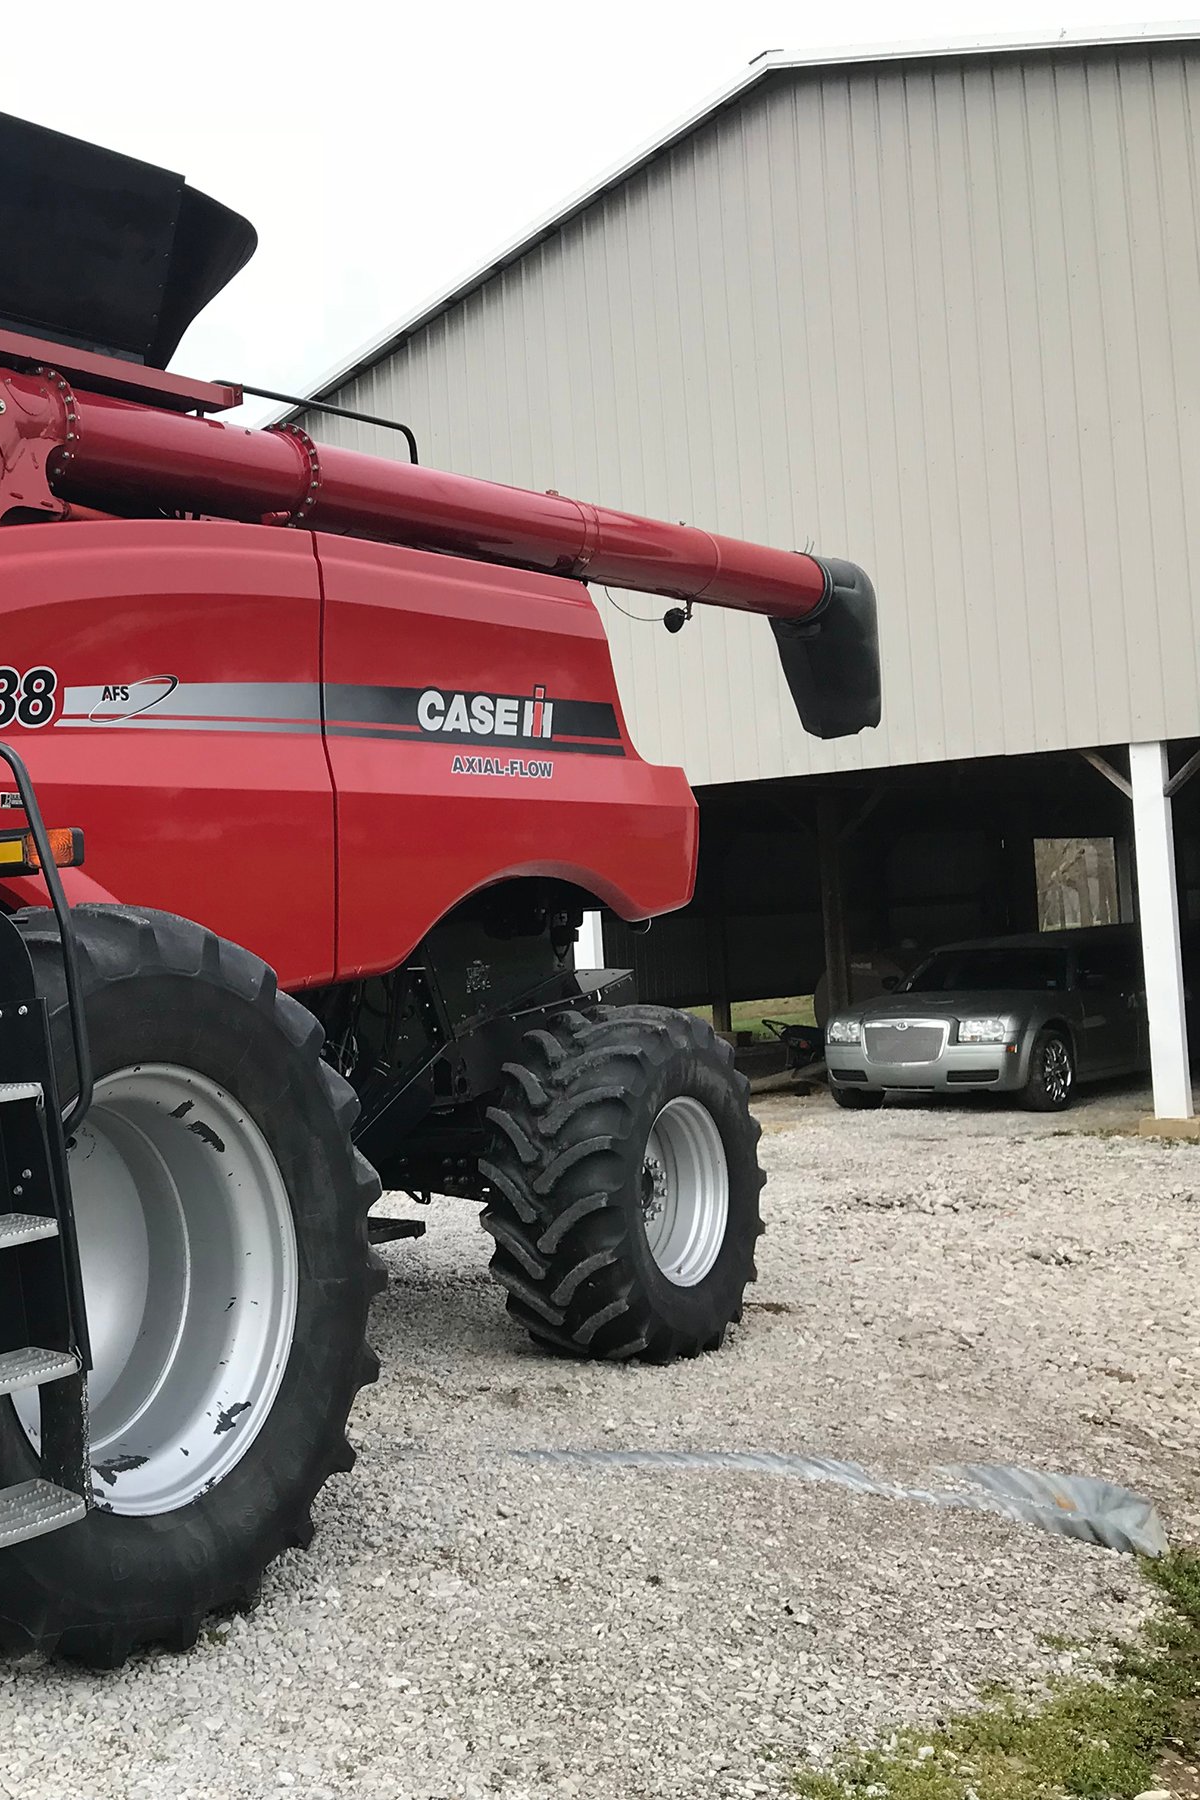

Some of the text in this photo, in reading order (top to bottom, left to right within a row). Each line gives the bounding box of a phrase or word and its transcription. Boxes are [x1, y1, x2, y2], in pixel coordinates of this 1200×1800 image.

[101, 685, 130, 702] AFS
[416, 689, 519, 736] CASE
[451, 755, 553, 779] AXIAL-FLOW
